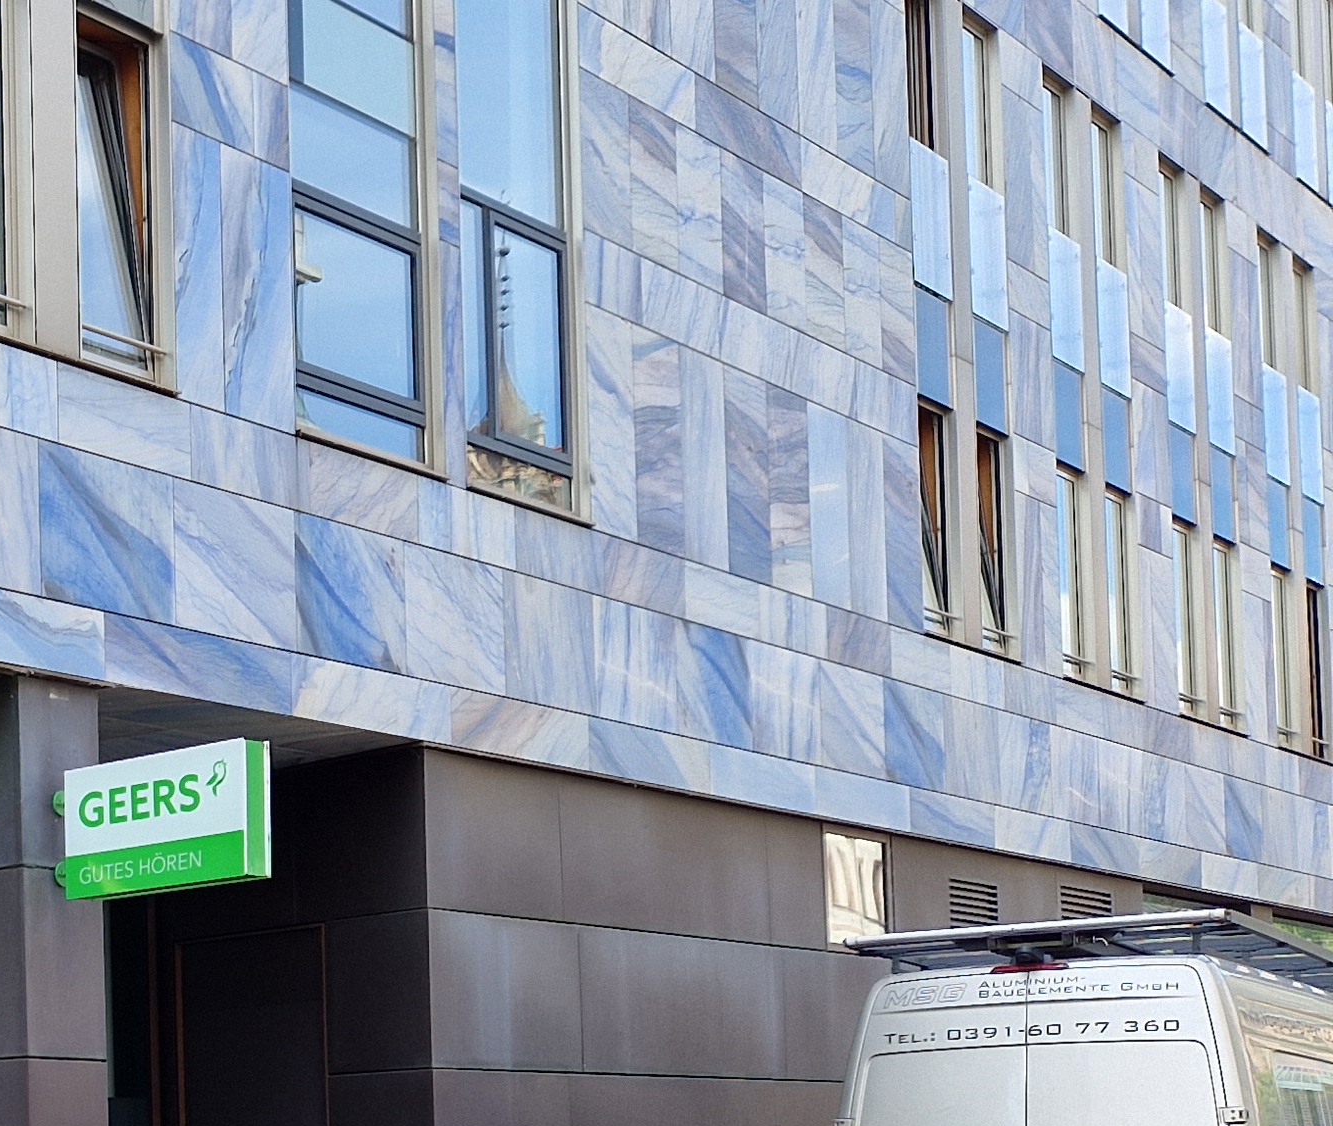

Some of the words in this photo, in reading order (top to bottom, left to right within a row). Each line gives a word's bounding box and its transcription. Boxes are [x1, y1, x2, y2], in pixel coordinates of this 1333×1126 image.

[79, 773, 201, 828] GEERS
[79, 860, 133, 885] GUTES
[139, 850, 203, 876] HÖREN
[884, 983, 967, 1009] MSG
[947, 1023, 1063, 1041] 0391-60
[1075, 1021, 1111, 1035] 77
[1124, 1019, 1181, 1033] 360
